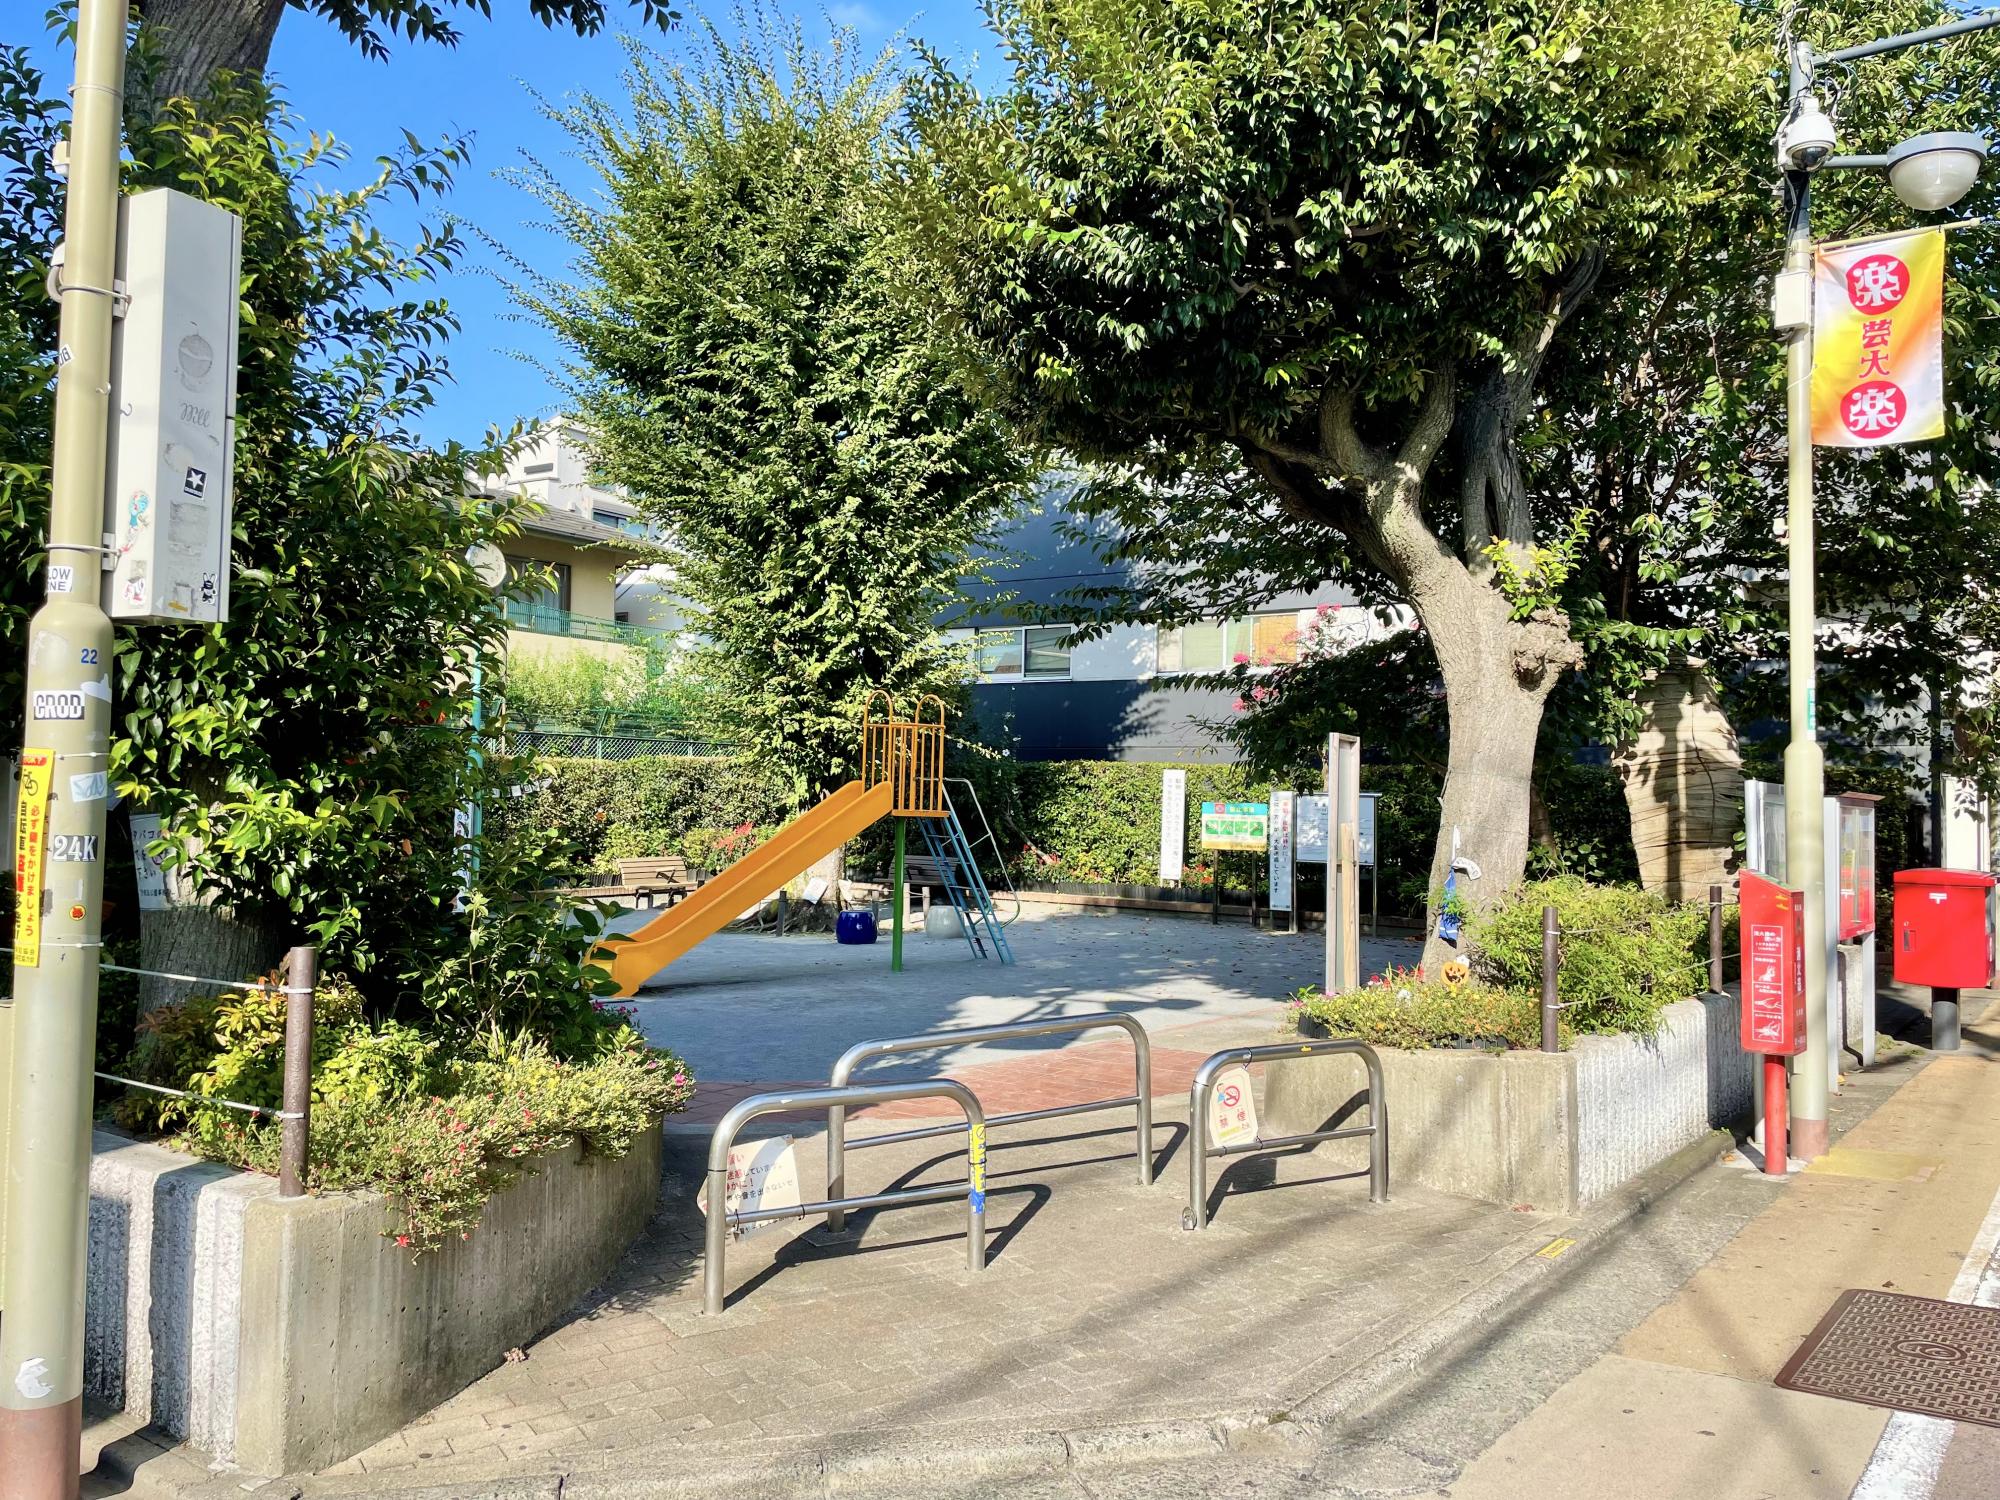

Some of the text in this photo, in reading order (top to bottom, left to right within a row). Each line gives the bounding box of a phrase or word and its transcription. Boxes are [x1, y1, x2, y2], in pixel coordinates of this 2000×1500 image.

[1850, 260, 1902, 432] 楽 芸大 楽
[48, 567, 71, 580] OW
[48, 581, 66, 592] NE
[80, 648, 98, 665] 22
[53, 835, 97, 862] 24K
